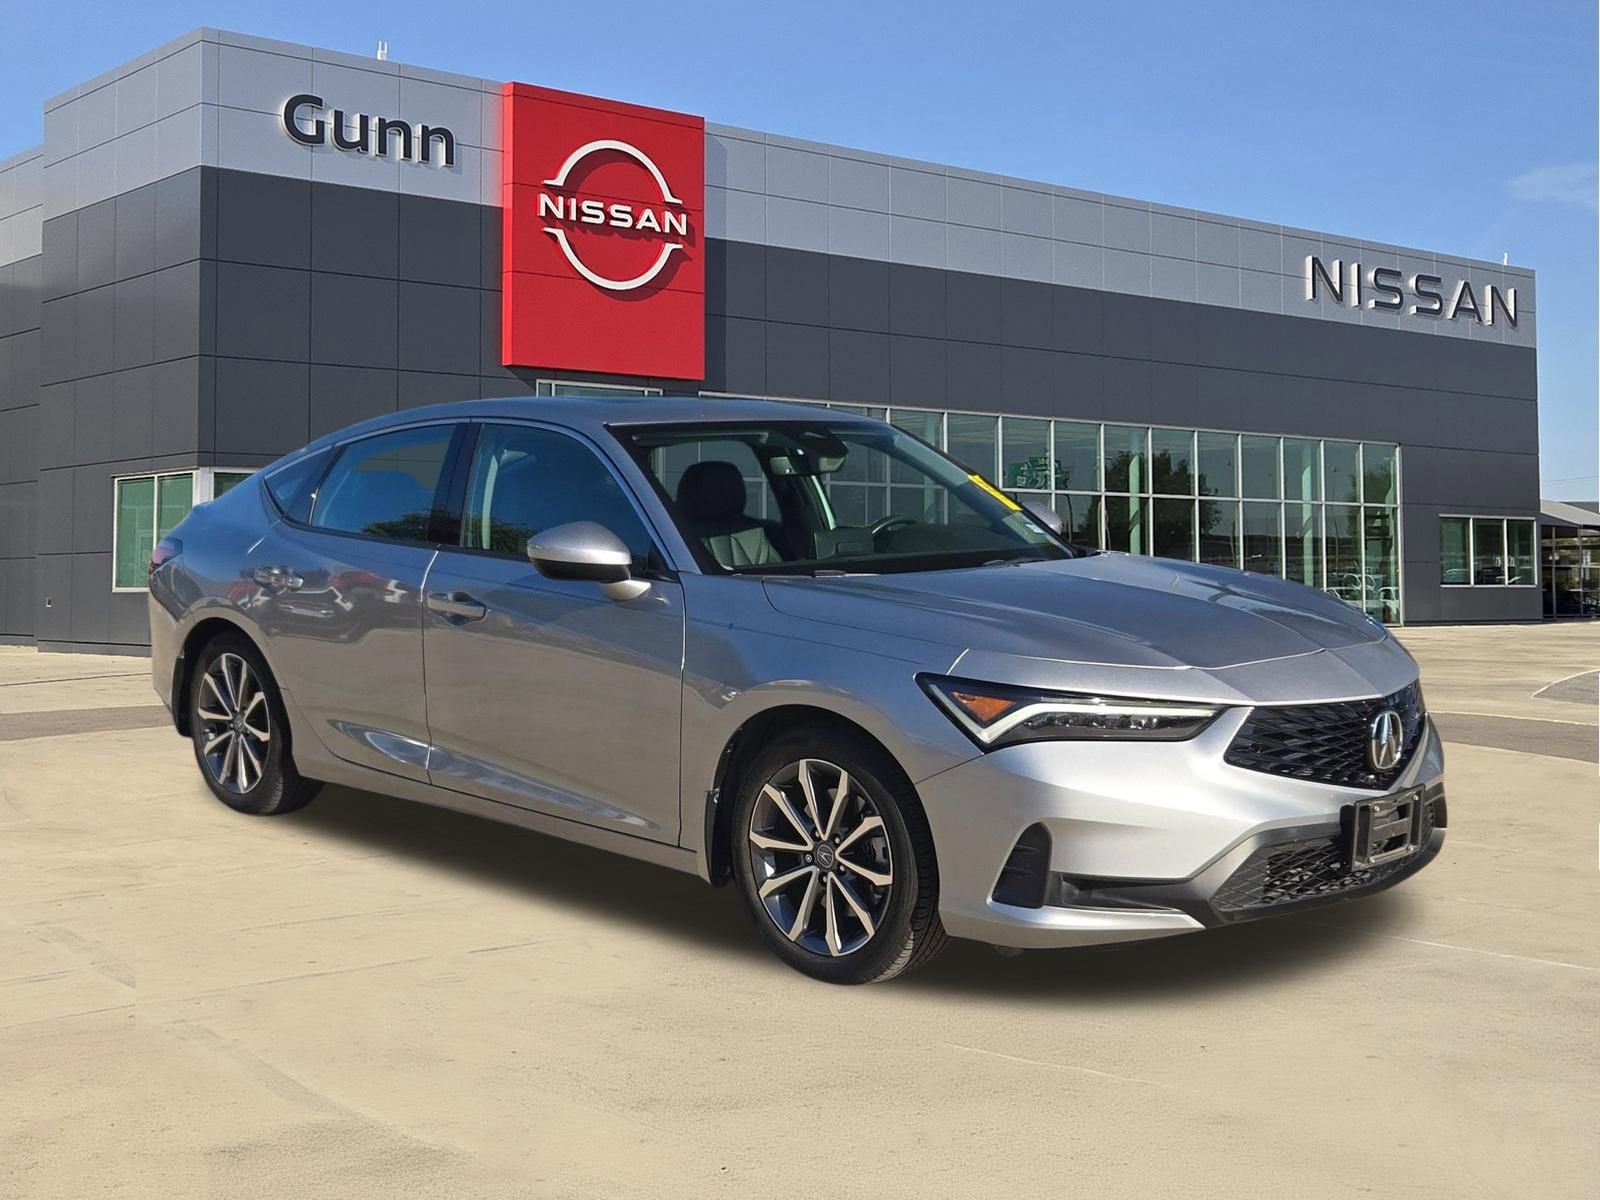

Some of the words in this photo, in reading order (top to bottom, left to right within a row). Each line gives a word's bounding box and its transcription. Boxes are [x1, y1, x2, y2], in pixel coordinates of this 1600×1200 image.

[282, 94, 455, 167] Gunn
[538, 193, 687, 235] NISSAN
[1305, 255, 1517, 328] NISSAN
